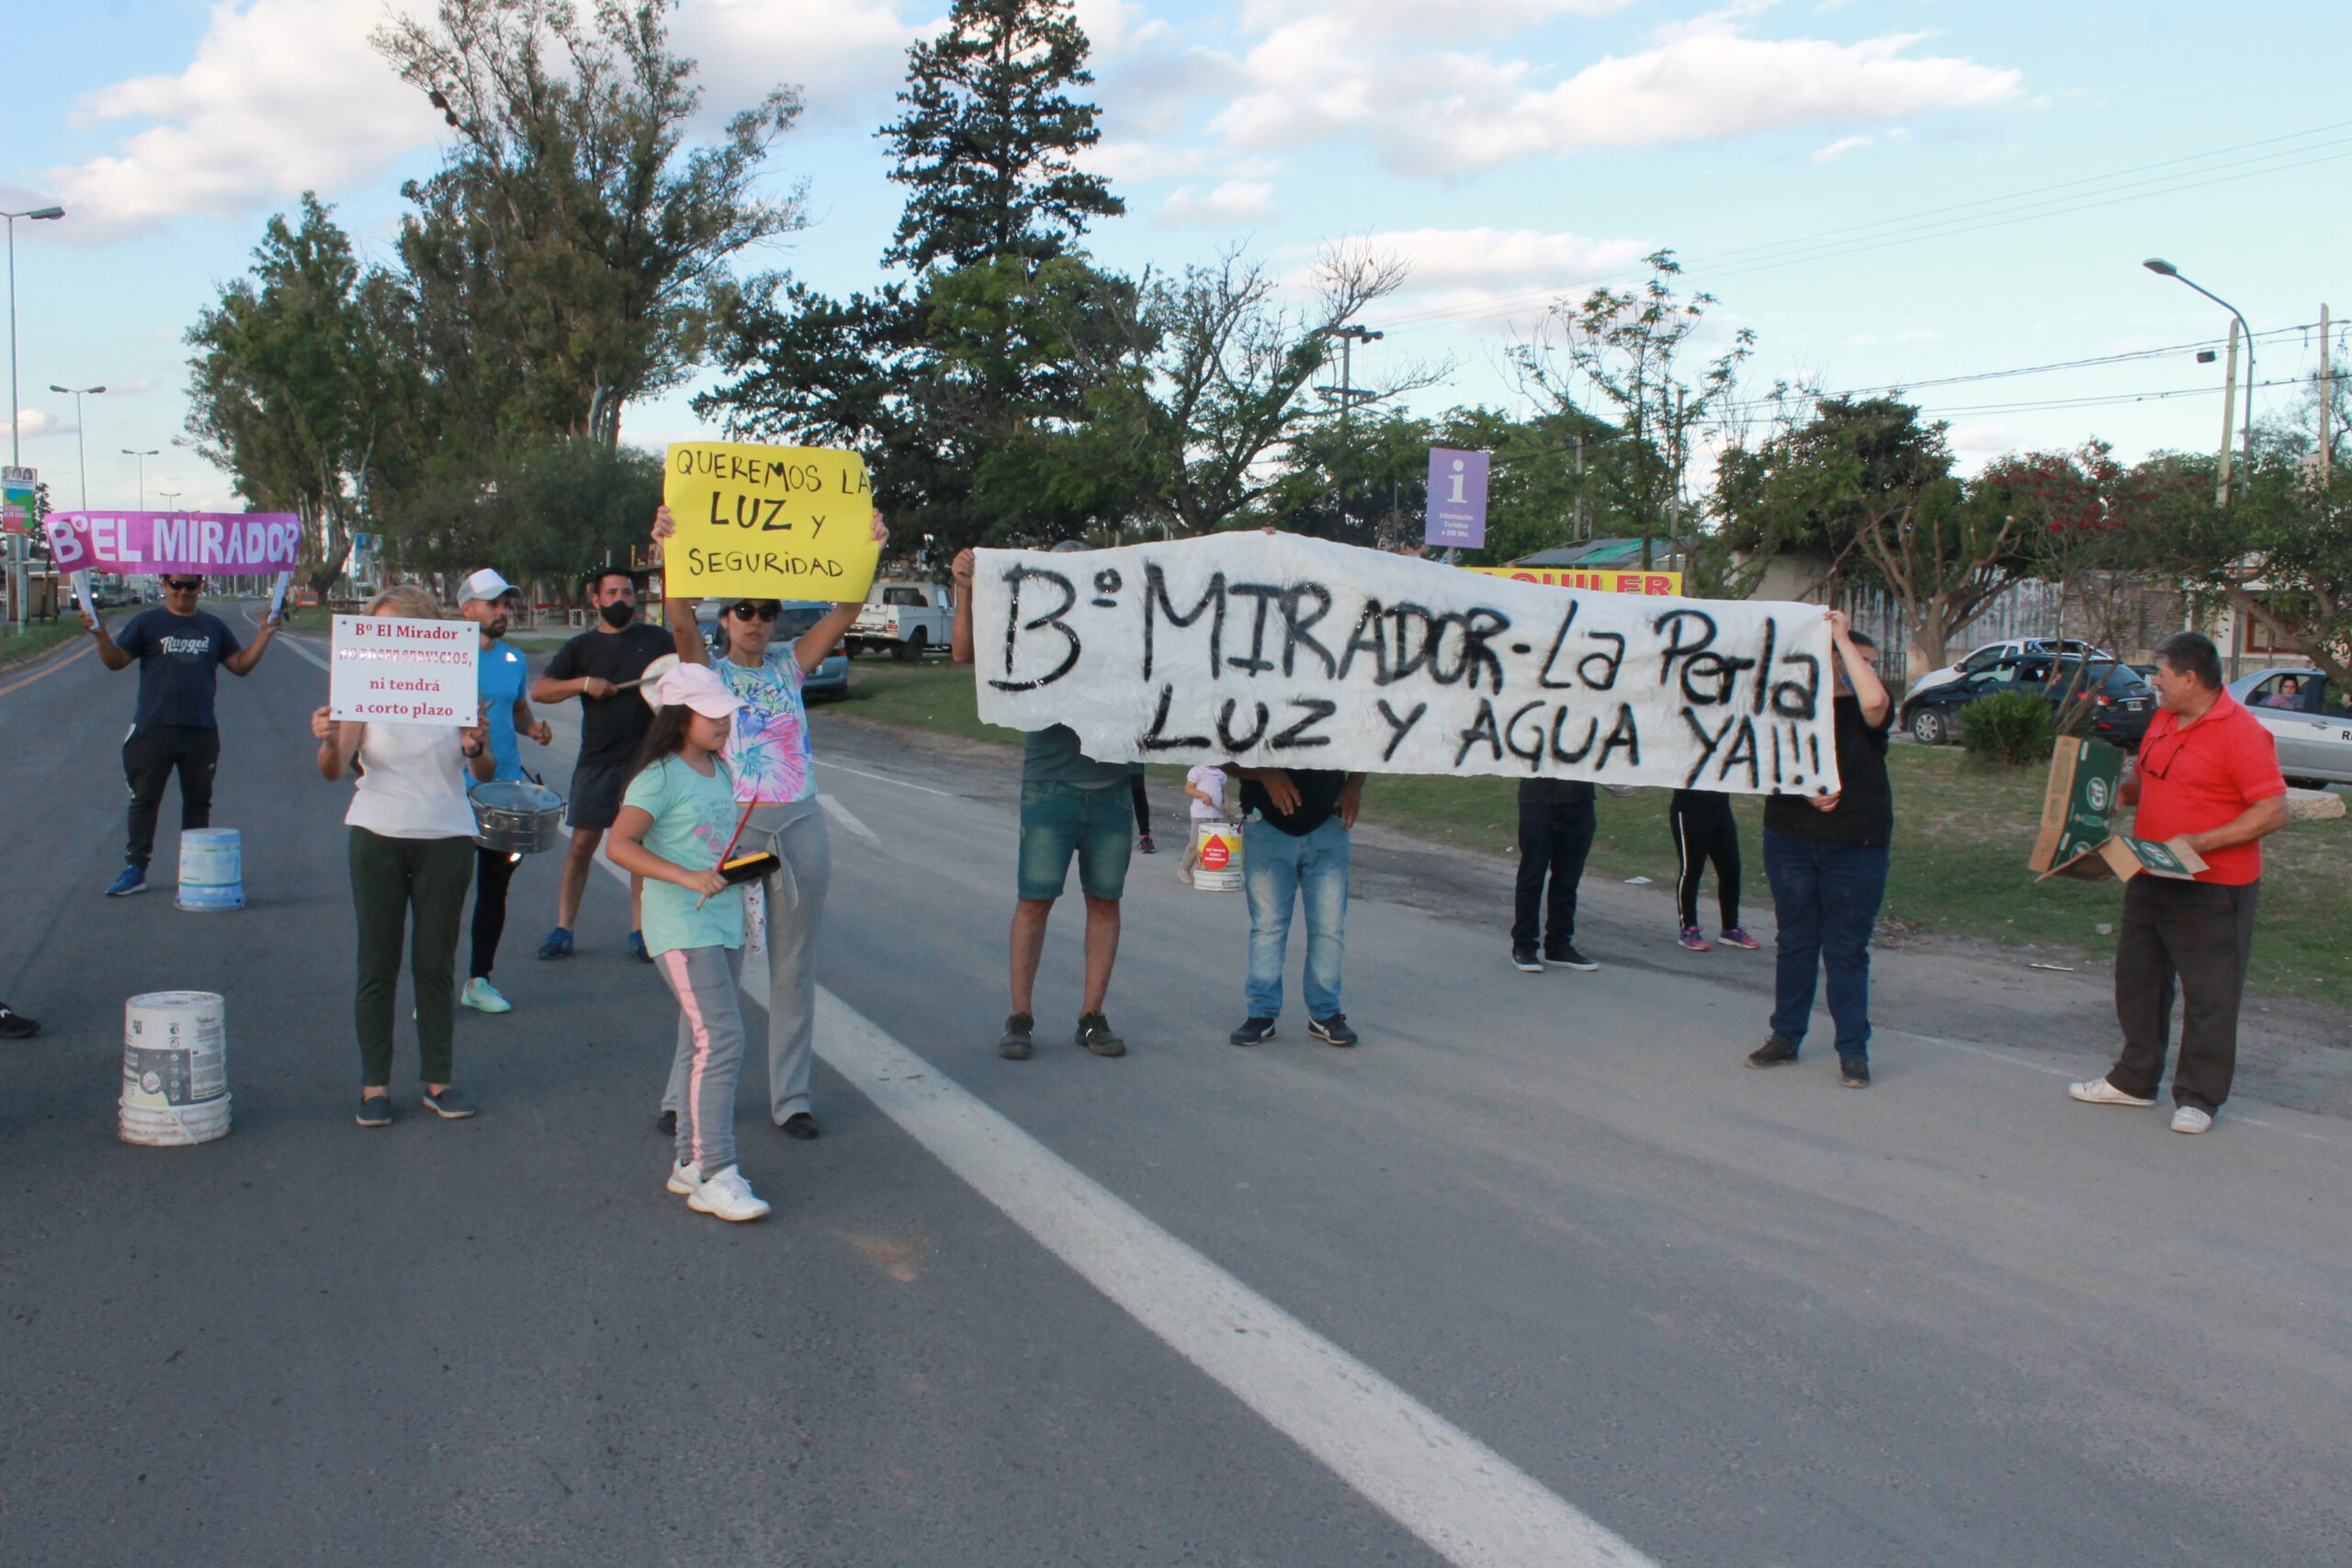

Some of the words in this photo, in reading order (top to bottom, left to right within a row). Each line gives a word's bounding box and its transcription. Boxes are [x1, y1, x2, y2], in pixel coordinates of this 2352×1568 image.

[677, 449, 822, 492] QUEREMOS
[842, 468, 873, 494] LA
[710, 491, 792, 531] LUZ
[91, 518, 142, 562] EL
[153, 518, 300, 564] MIRADOR
[160, 636, 209, 654] Rugged
[378, 624, 391, 637] El
[397, 625, 458, 639] Mirador
[369, 677, 385, 690] ni
[390, 678, 440, 692] tendrá
[1654, 609, 1820, 720] Perla
[355, 704, 364, 713] a
[368, 704, 408, 714] corto
[413, 703, 454, 718] plazo
[1138, 683, 1336, 753] LUZ
[1377, 698, 1427, 762] Y
[1454, 698, 1640, 772] AGUA
[1679, 705, 1828, 795] YA!!!
